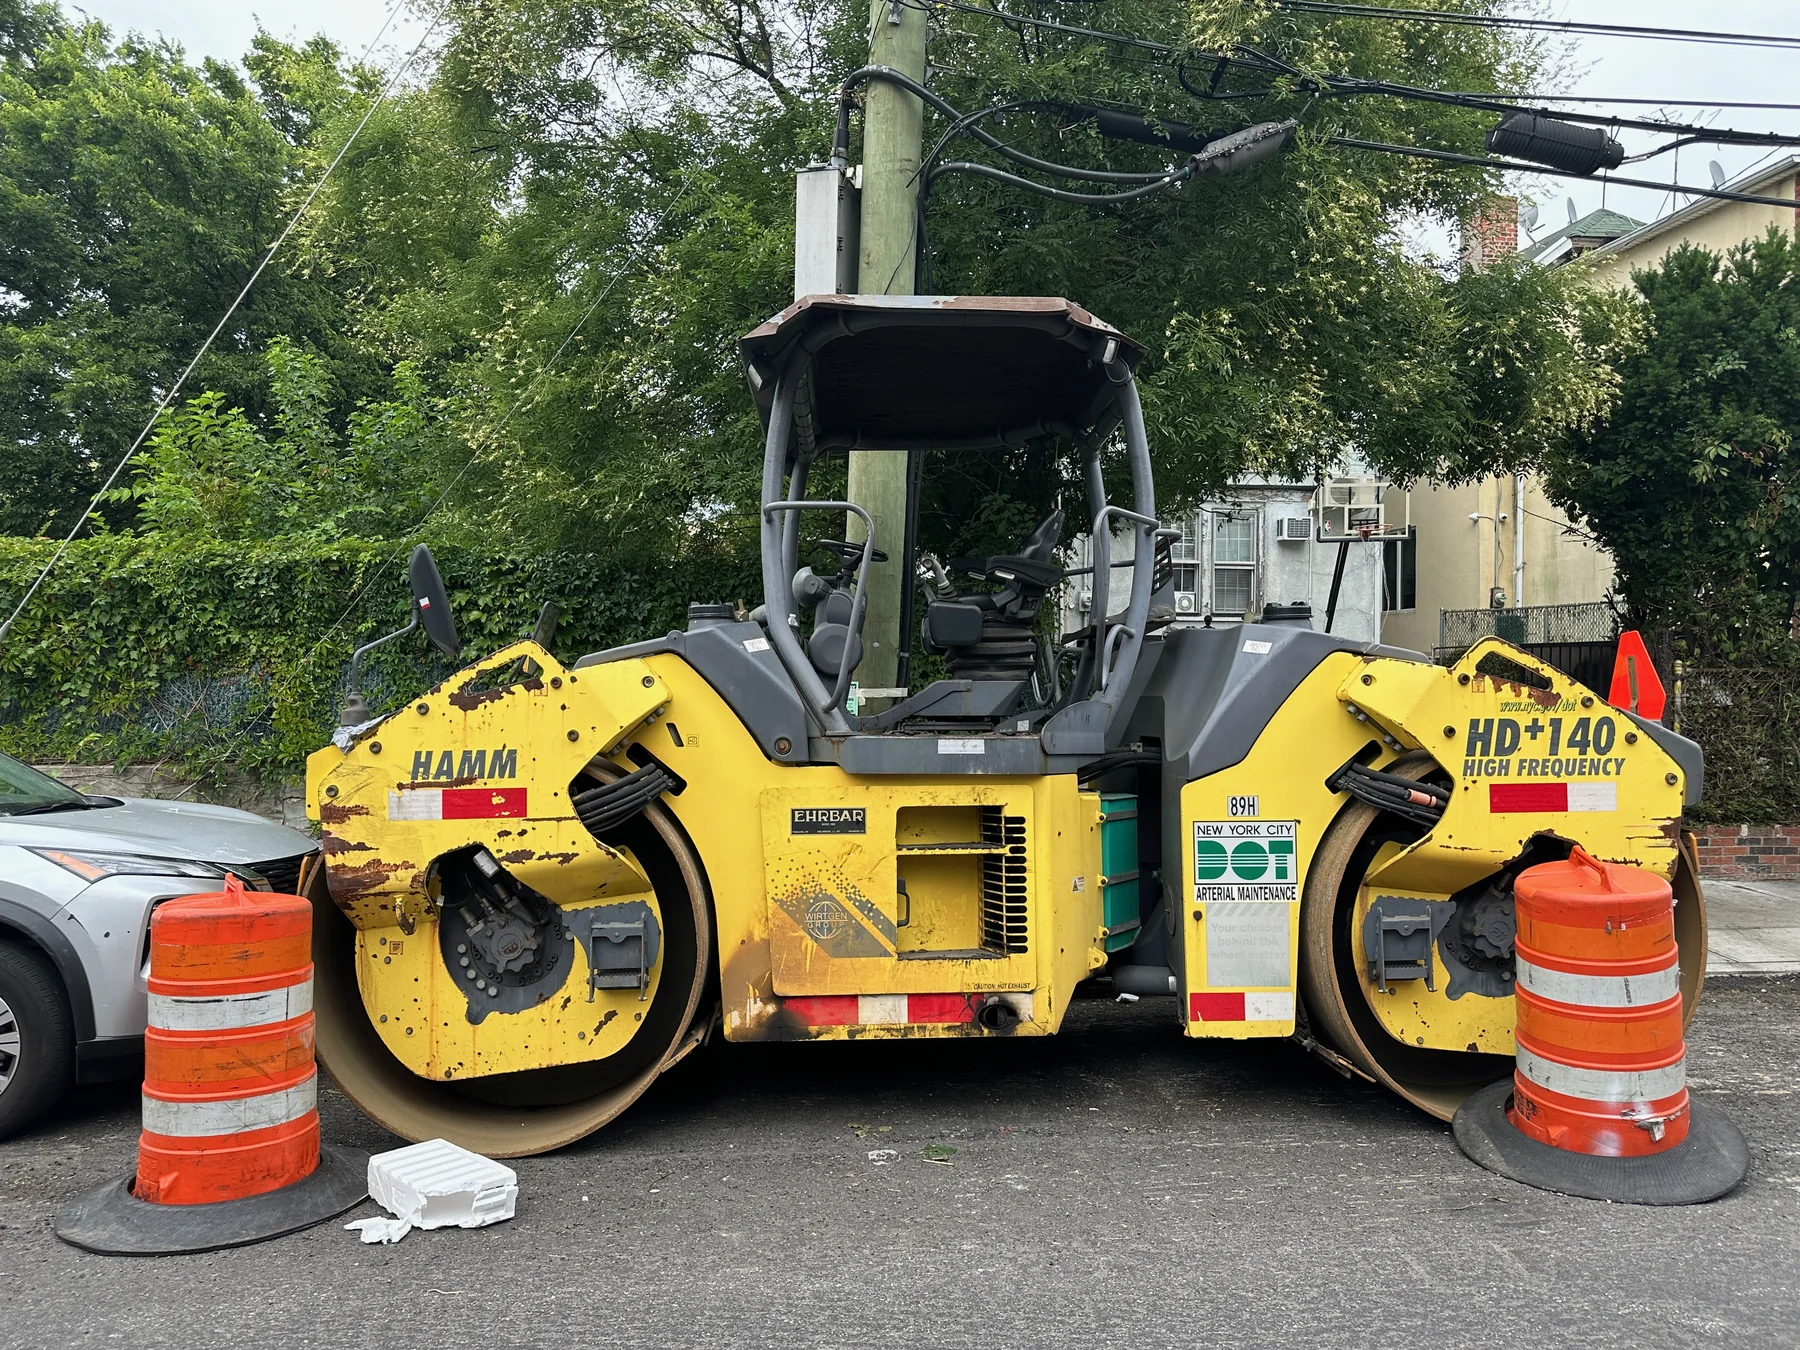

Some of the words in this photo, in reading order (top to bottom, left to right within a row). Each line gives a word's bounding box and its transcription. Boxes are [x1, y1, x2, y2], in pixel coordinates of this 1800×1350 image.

[411, 749, 517, 780] HAMM
[1463, 759, 1510, 776] HIGH
[1517, 758, 1626, 778] FREQUENCY
[1231, 796, 1255, 816] 89H
[794, 810, 864, 822] EHRBAR
[1197, 825, 1223, 835] NEW
[1229, 825, 1261, 835] YORK
[1267, 825, 1292, 835] CITY
[1198, 840, 1293, 880] DOT
[1196, 886, 1235, 901] ARTERIAL
[1237, 886, 1296, 901] MAINTENANCE
[805, 912, 848, 920] WIRTGEN
[807, 921, 845, 929] GROUP
[1211, 923, 1237, 933] Your
[1240, 923, 1284, 933] choices
[1218, 936, 1256, 946] behind
[1211, 950, 1245, 960] wheel
[1248, 951, 1286, 960] matter
[997, 982, 1008, 990] HOT
